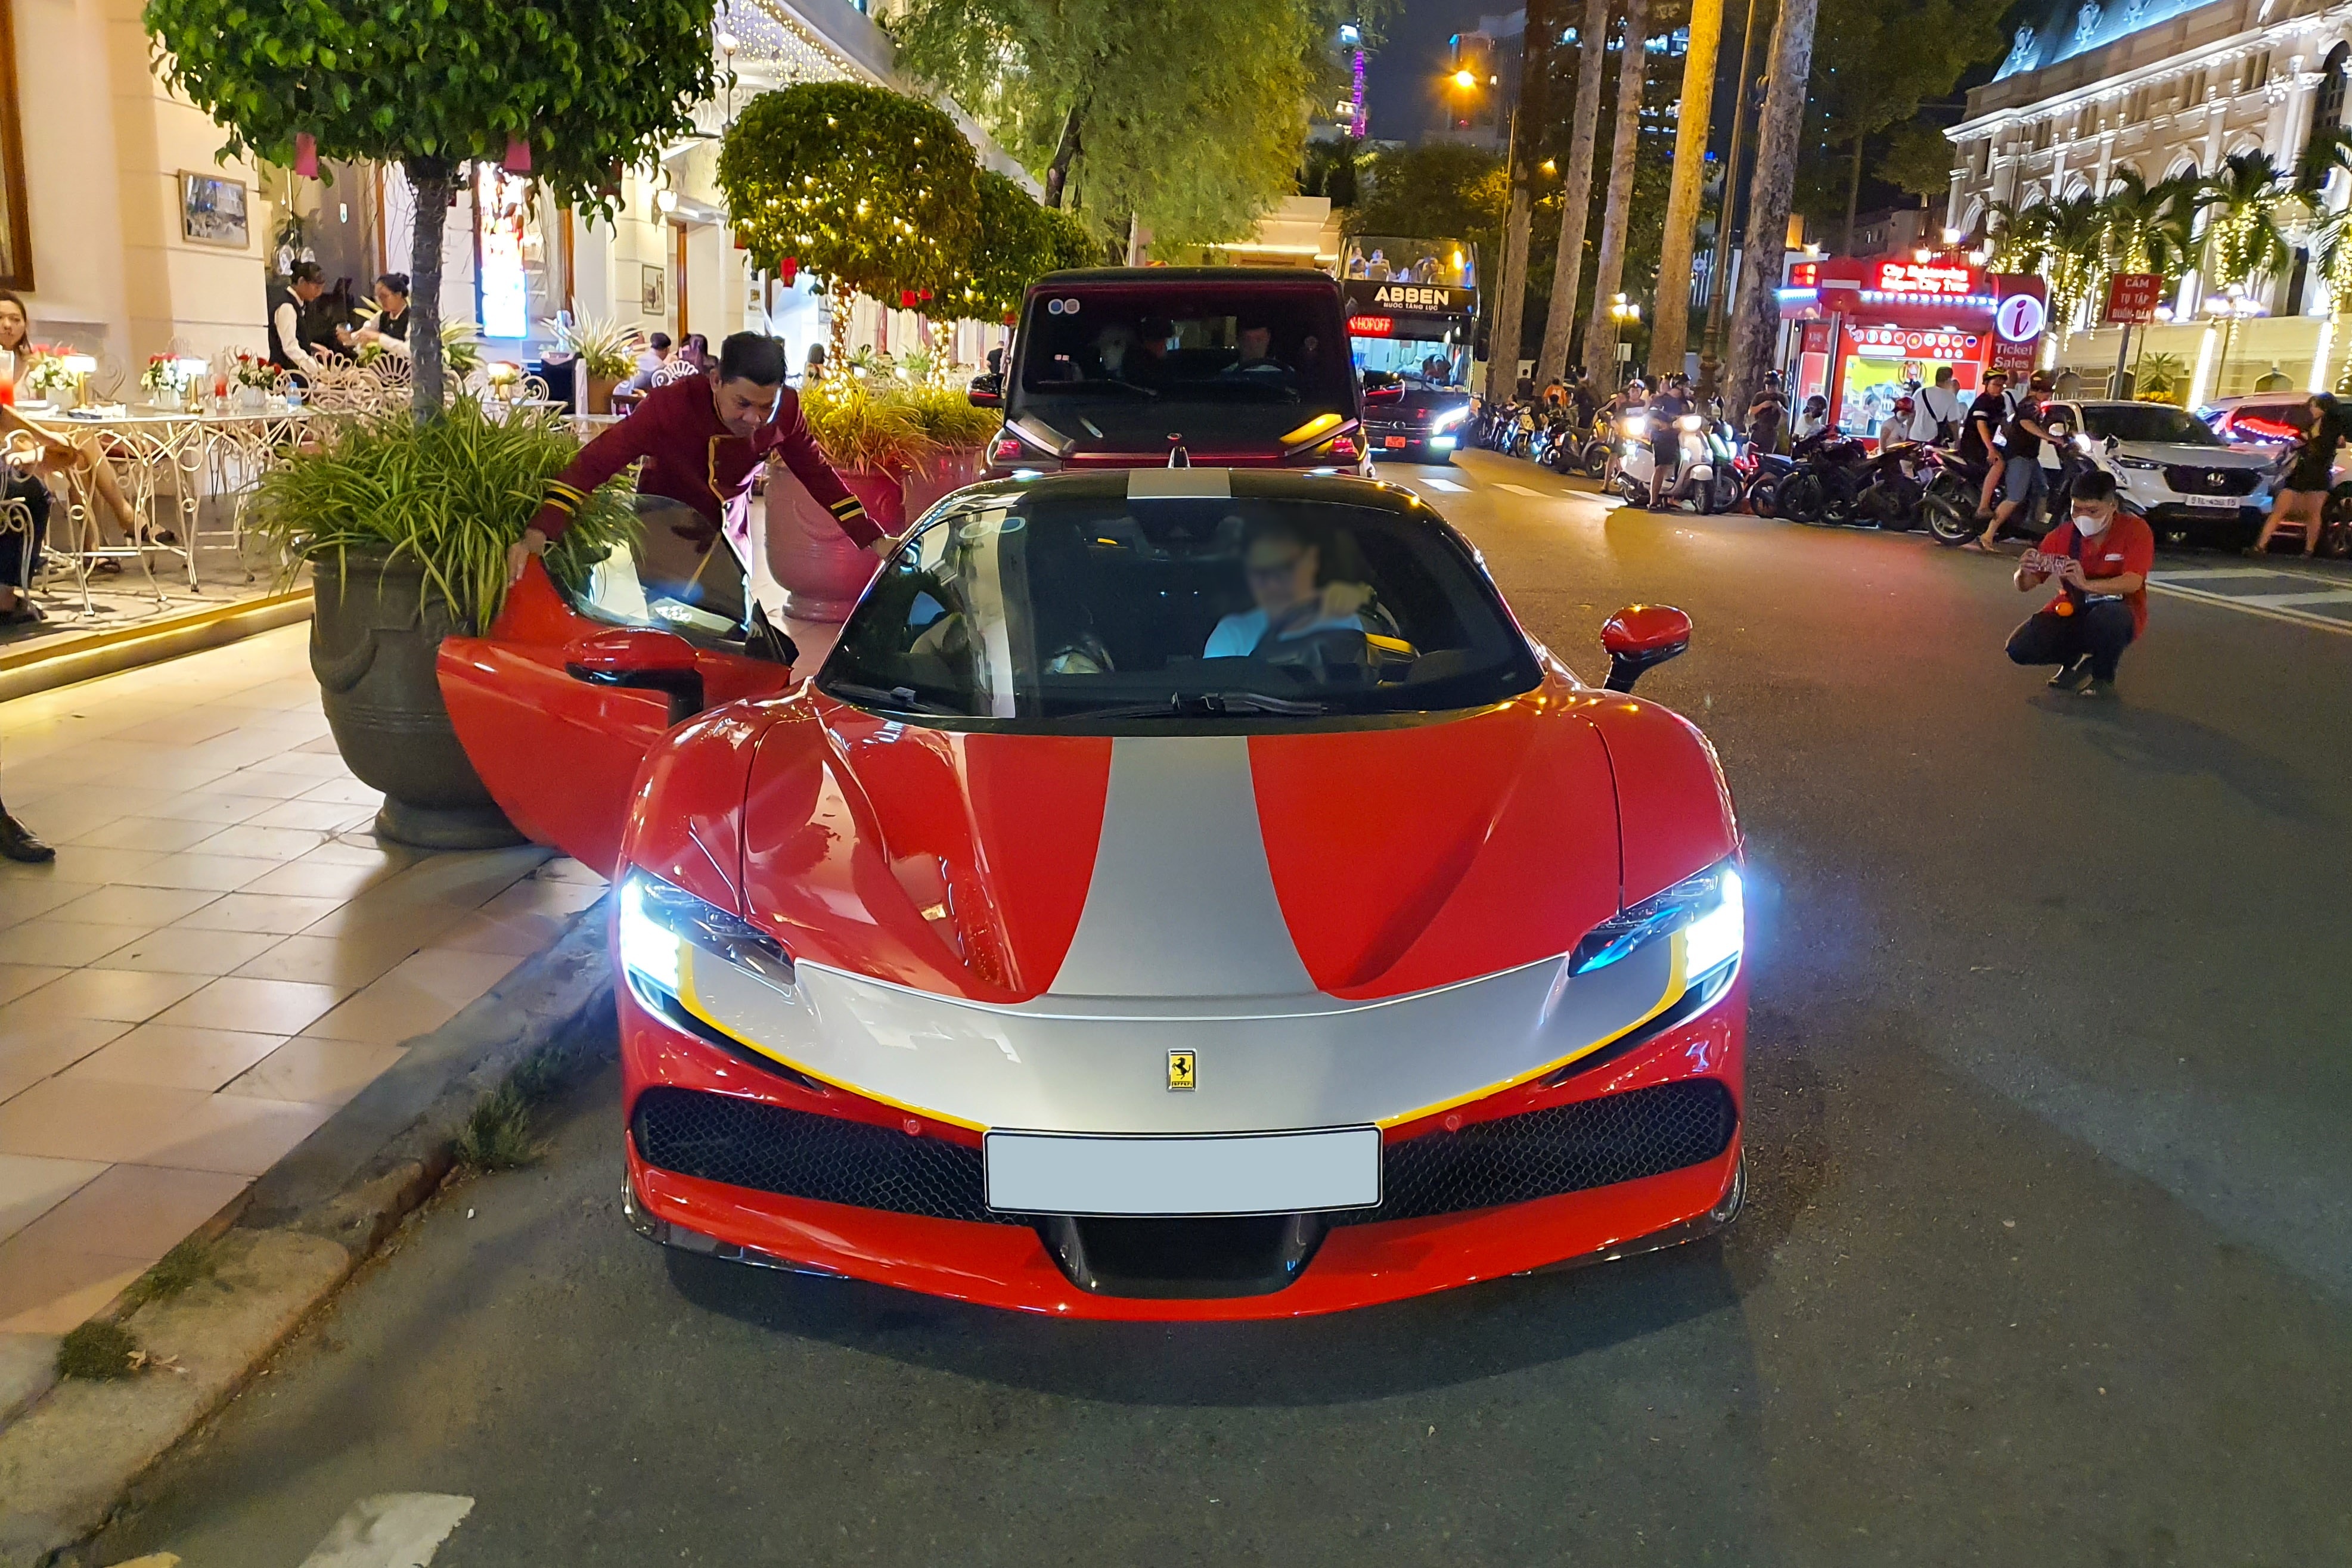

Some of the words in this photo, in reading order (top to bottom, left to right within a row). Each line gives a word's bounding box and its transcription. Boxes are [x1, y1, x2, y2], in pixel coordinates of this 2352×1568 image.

[1374, 286, 1449, 306] ABBEN
[1996, 343, 2033, 355] Ticket
[1993, 356, 2030, 368] Sales
